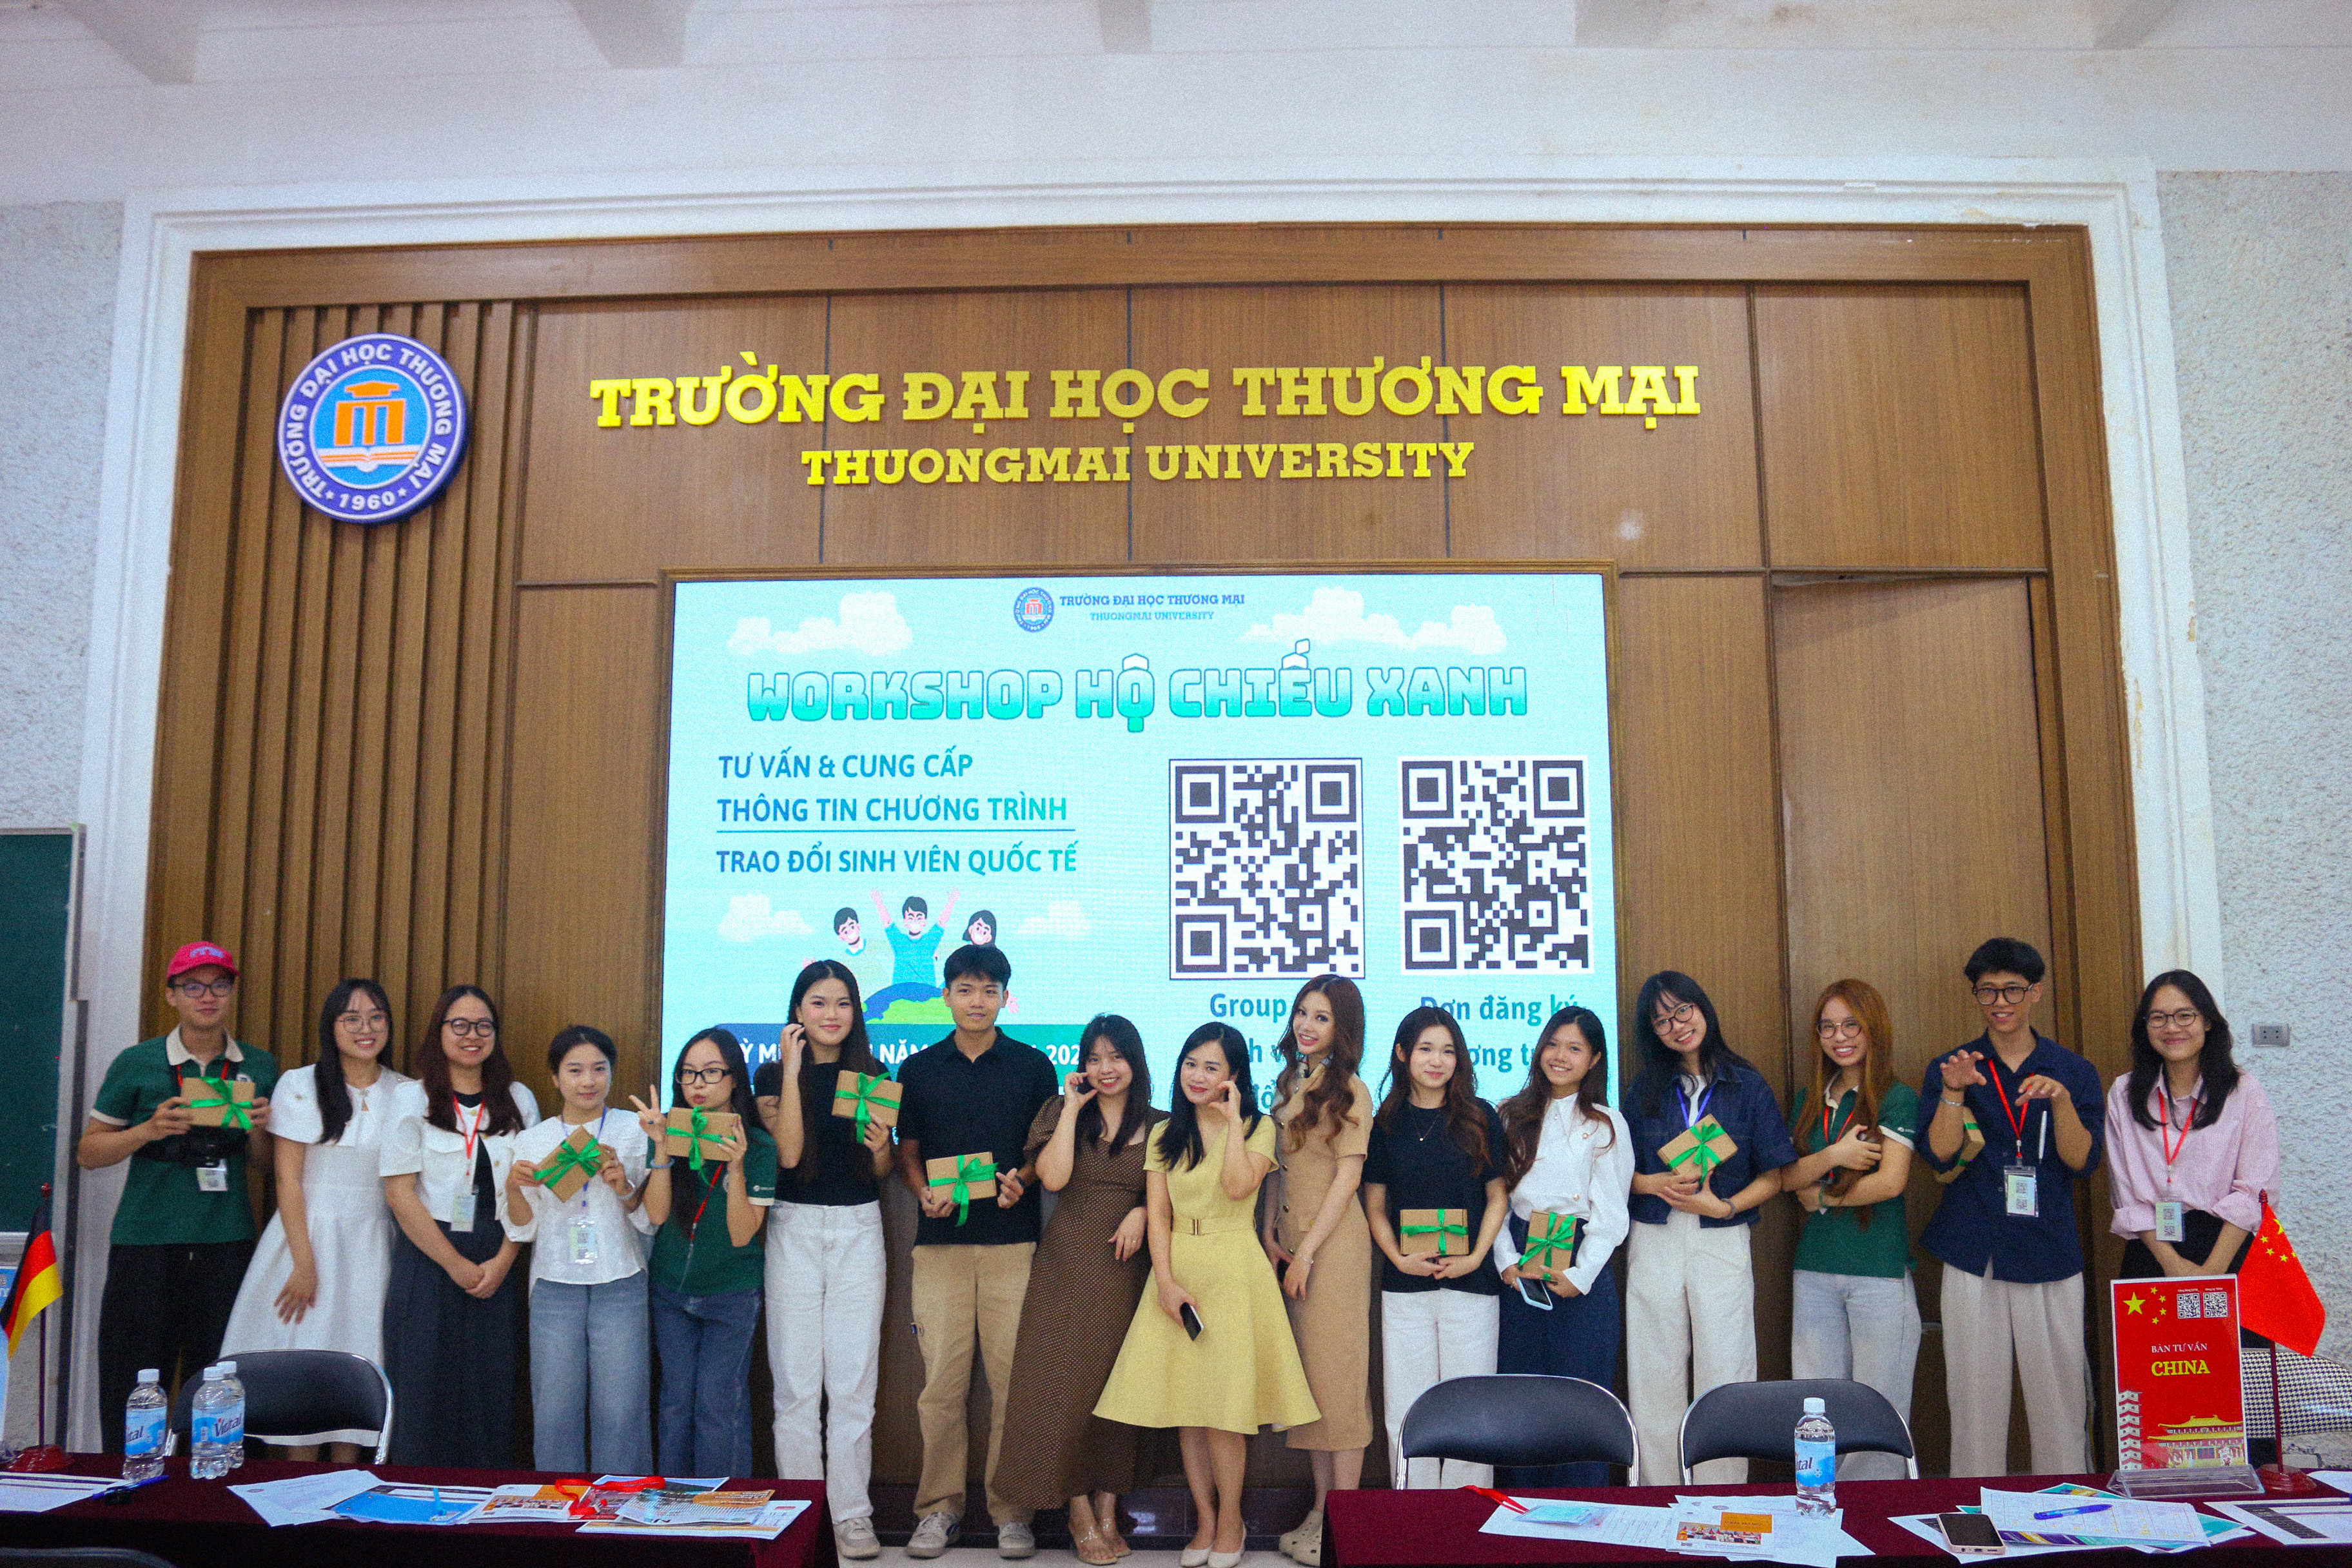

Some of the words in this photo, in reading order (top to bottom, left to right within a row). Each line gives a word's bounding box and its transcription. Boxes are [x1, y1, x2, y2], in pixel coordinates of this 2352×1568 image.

[341, 344, 393, 365] HỌC
[399, 348, 452, 436] THƯƠNG
[590, 351, 885, 427] TRƯỜNG
[903, 370, 1030, 433] ĐẠI
[1050, 368, 1210, 433] HỌC
[1233, 355, 1544, 416] THƯƠNG
[1561, 366, 1701, 429] MẠI
[409, 442, 447, 489] MẠI
[801, 447, 1131, 485] THUONGMAI
[1145, 442, 1475, 480] UNIVERSITY
[339, 491, 396, 511] 1960
[1137, 595, 1164, 608] HỌC
[1155, 611, 1214, 620] UNIVERSITY
[747, 669, 1063, 721] WORKSHOP
[1075, 653, 1155, 733] HỘ
[1169, 639, 1353, 718] CHIẾU
[1366, 667, 1528, 716] XANH
[718, 752, 753, 778] TƯ
[760, 746, 810, 778] VẤN
[819, 755, 836, 778] &
[842, 754, 915, 778] CUNG
[923, 745, 974, 778] CẤP
[717, 793, 808, 822] THÔNG
[816, 798, 858, 822] TIN
[866, 794, 979, 822] CHƯƠNG
[988, 791, 1067, 821] TRÌNH
[716, 850, 780, 873] TRAO
[787, 840, 831, 873] ĐỔI
[839, 850, 896, 872] SINH
[904, 845, 960, 872] VIÊN
[968, 841, 1042, 876] QUỐC
[1048, 839, 1079, 872] TẾ
[1210, 993, 1287, 1023] Group
[1480, 994, 1542, 1027] đăng
[1046, 1044, 1081, 1065] 202
[2151, 1344, 2171, 1353] BÀN
[2172, 1343, 2186, 1352] TƯ
[2187, 1341, 2208, 1351] VẤN
[2151, 1359, 2211, 1377] CHINA
